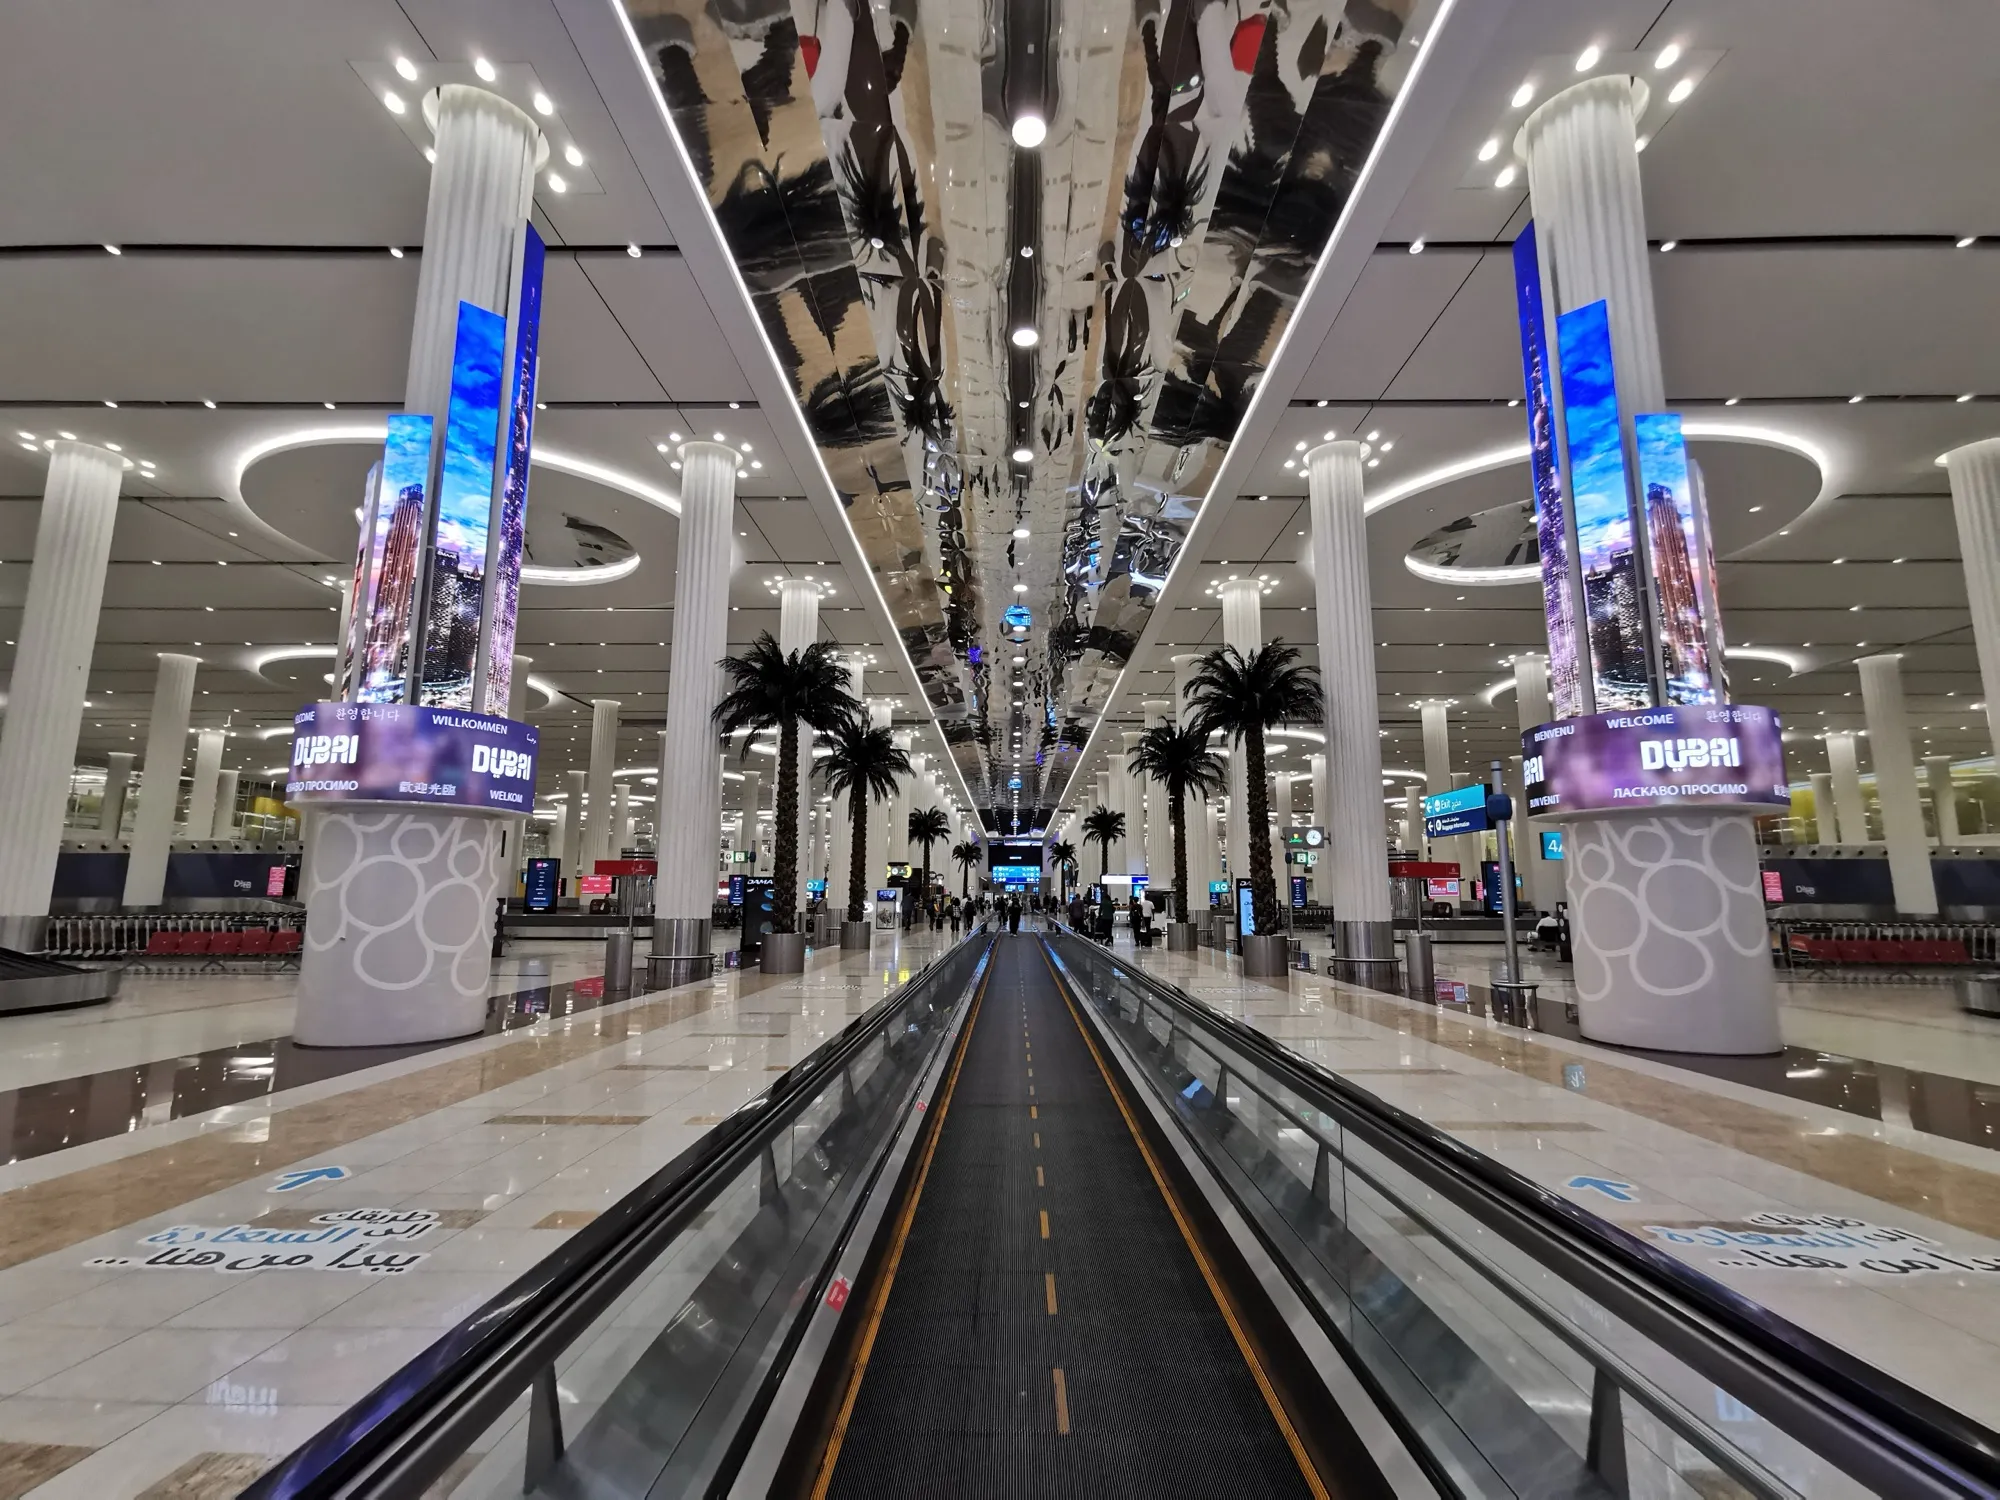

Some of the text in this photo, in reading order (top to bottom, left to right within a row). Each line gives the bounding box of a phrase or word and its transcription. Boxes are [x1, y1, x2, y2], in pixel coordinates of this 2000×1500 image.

[432, 715, 508, 734] WILLKOMMEN
[1606, 713, 1675, 729] WELCOME
[1534, 725, 1575, 742] BIENVENU
[293, 735, 359, 769] DUBAI
[1640, 737, 1741, 772] DUBAI
[472, 744, 532, 780] DUBAI
[305, 781, 359, 791] ПРОСИМО
[1613, 784, 1748, 799] ЛАСКАВО ПРОСИМО
[1441, 799, 1451, 809] Exit
[319, 1210, 431, 1224] طريقك
[225, 1254, 314, 1270] من
[325, 1242, 421, 1273] يبدأ
